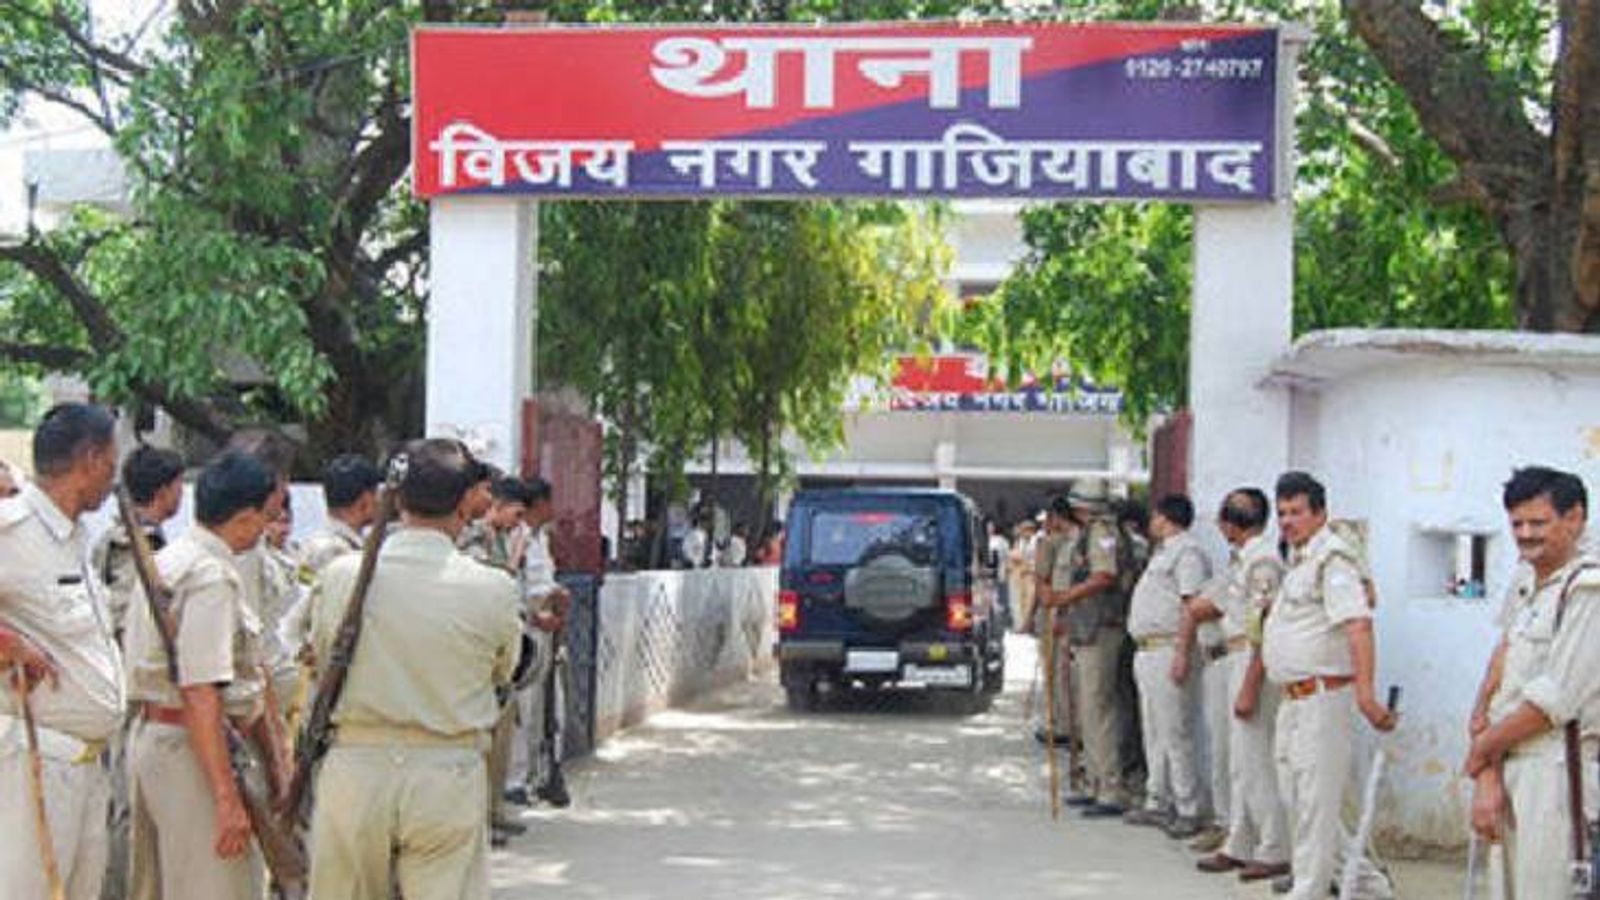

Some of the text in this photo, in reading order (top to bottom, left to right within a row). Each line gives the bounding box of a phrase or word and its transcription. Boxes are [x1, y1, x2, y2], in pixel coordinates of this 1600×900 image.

[650, 37, 1034, 108] थाना
[429, 122, 1262, 191] विजय नगर गाजियाबाद
